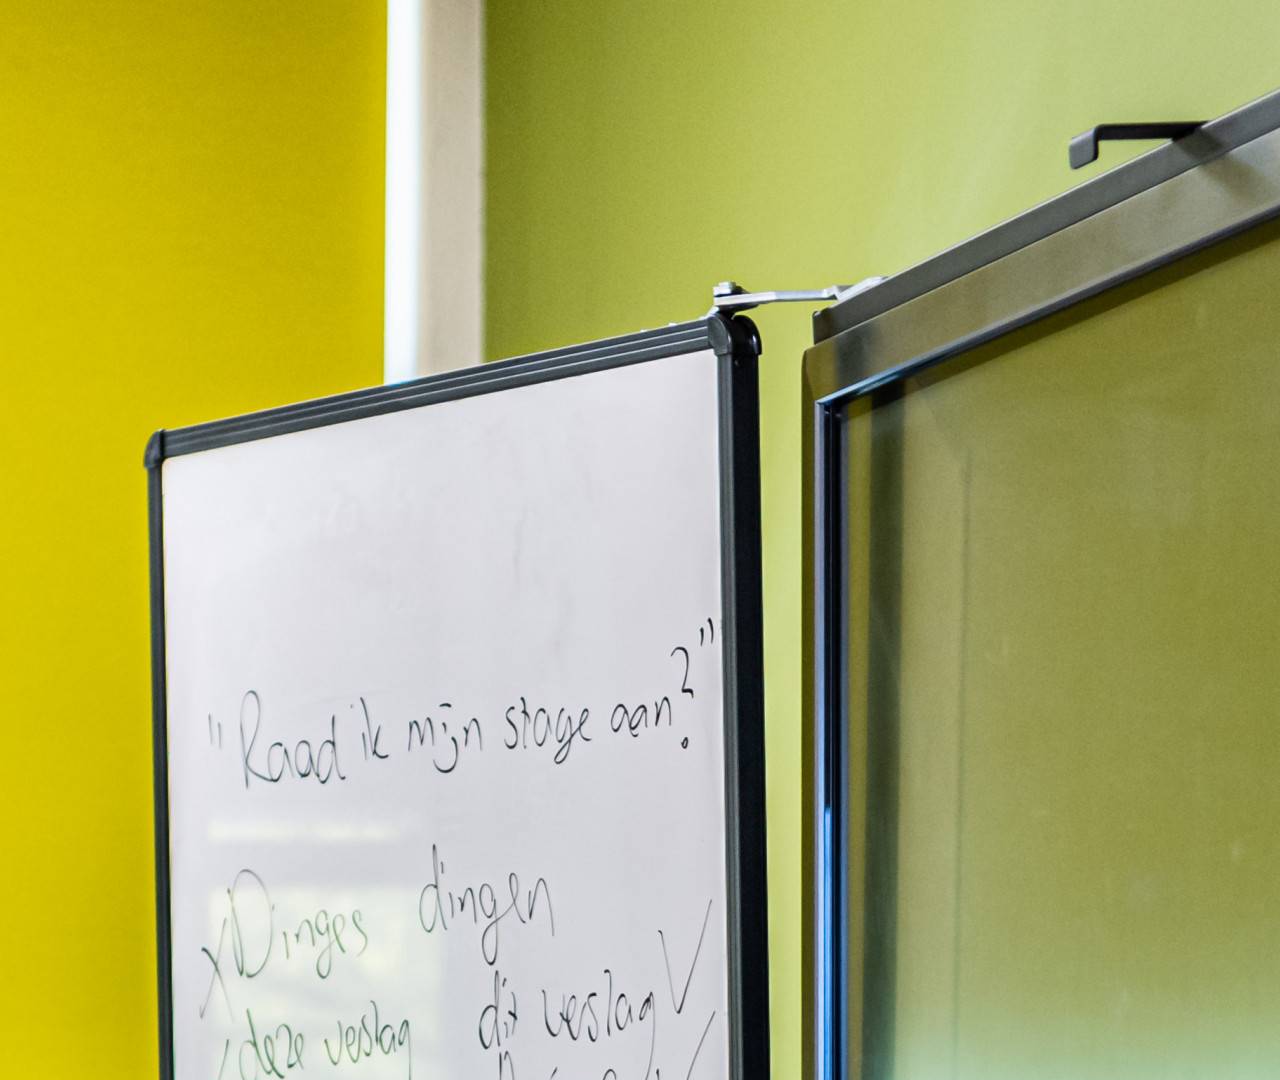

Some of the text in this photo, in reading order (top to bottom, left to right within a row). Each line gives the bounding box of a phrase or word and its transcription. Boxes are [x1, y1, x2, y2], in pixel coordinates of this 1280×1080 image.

[349, 696, 390, 761] ik
[407, 702, 484, 773] mijn
[503, 696, 593, 765] stage
[418, 843, 556, 966] dingen
[478, 969, 518, 1050] dit
